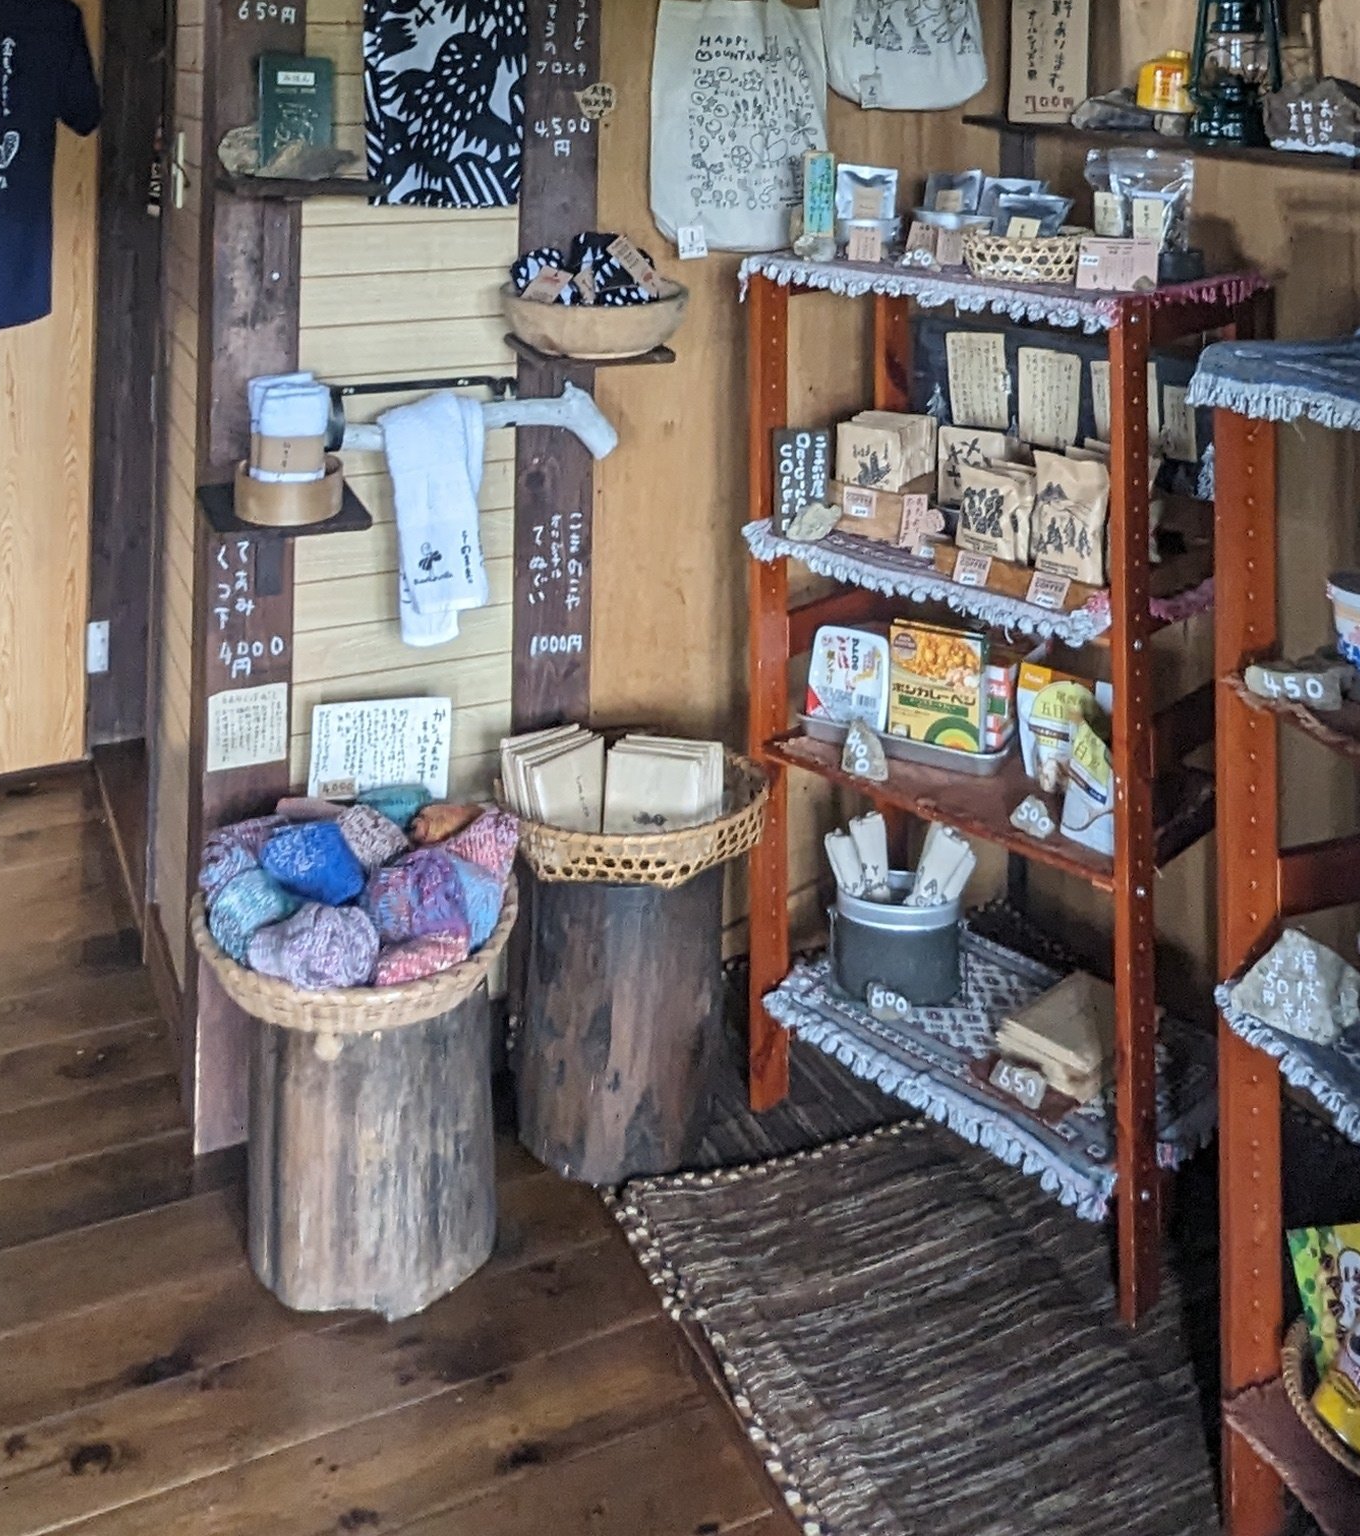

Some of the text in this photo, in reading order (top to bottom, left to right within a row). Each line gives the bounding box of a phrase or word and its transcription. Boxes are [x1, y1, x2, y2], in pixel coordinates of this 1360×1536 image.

[238, 0, 296, 24] 650円
[553, 139, 571, 157] 円
[901, 249, 932, 266] 200
[794, 432, 811, 513] ORIGINA
[529, 525, 549, 605] てぬぐい
[213, 544, 232, 631] くつ下
[219, 635, 284, 665] 4000
[529, 634, 583, 657] 1000円
[231, 656, 252, 678] 円
[1262, 672, 1325, 700] 450
[1017, 801, 1051, 833] 500
[999, 1066, 1036, 1097] 650
